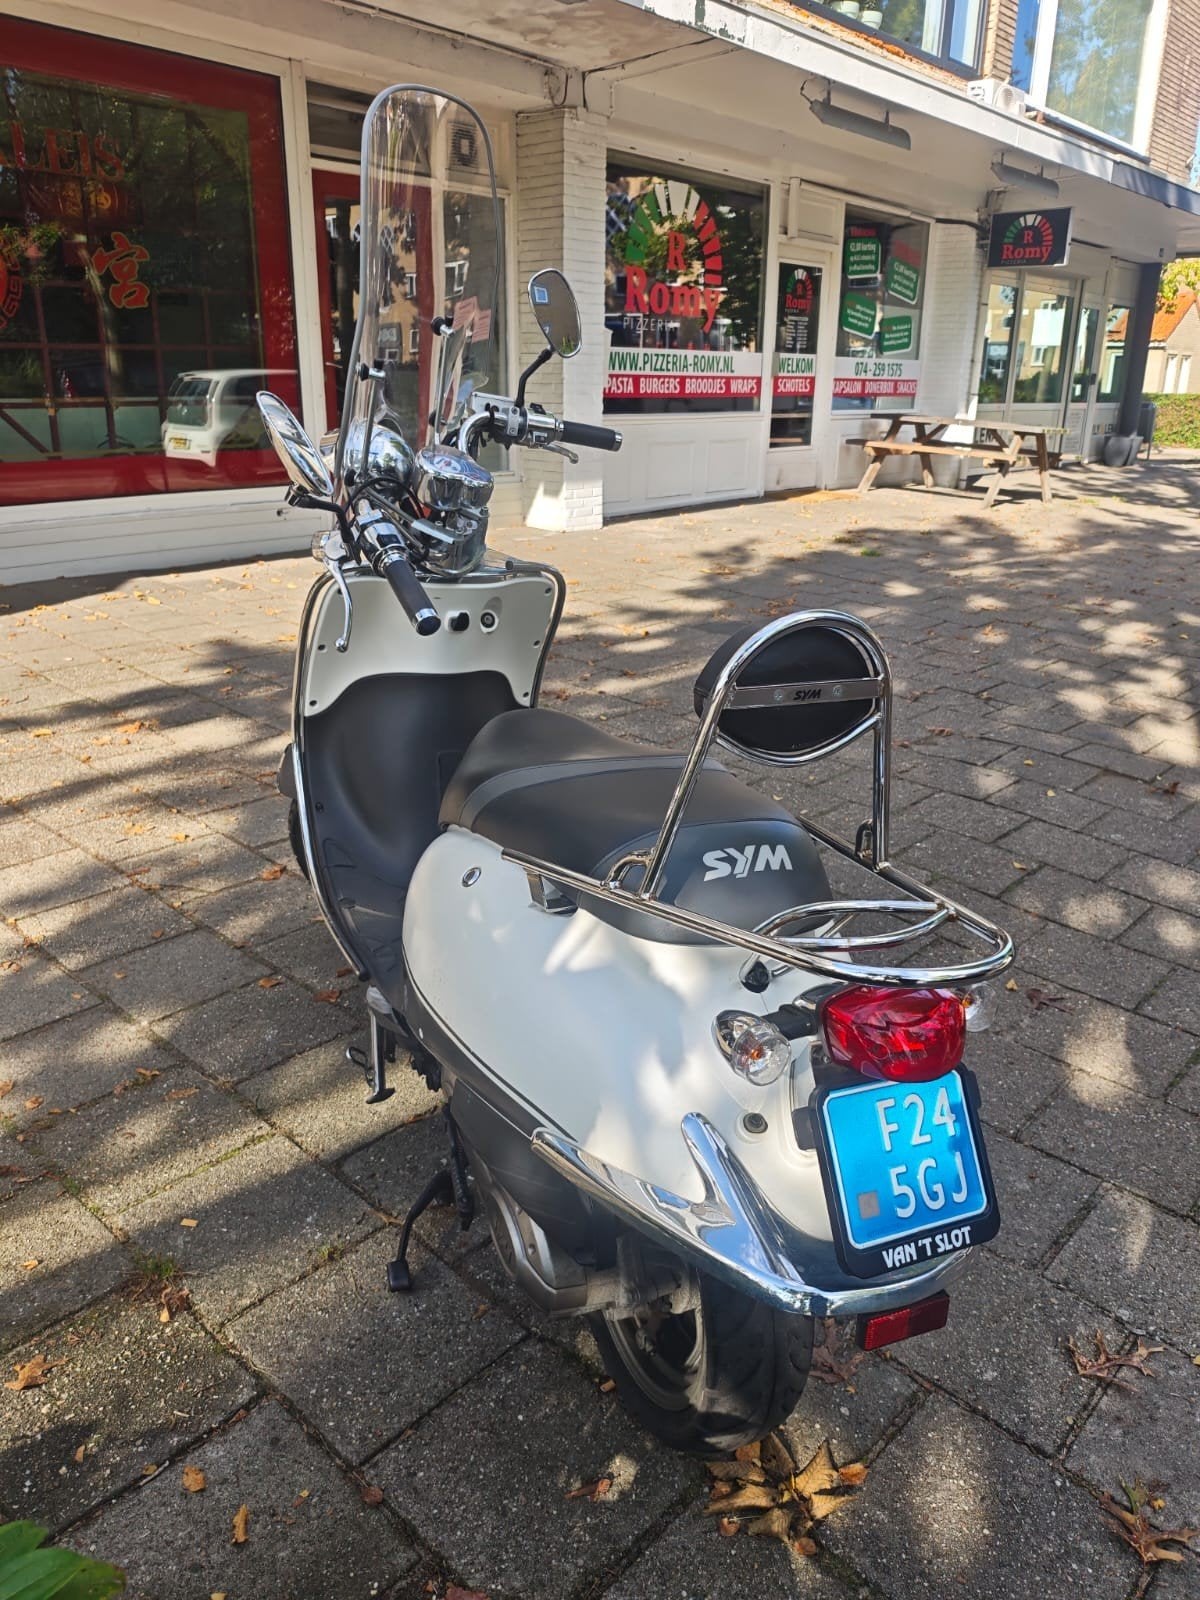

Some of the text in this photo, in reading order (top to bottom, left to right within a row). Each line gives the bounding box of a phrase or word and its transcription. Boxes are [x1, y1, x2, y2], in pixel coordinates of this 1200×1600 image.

[0, 121, 125, 182] LEIS
[668, 231, 686, 271] R
[1002, 243, 1052, 263] Romy
[624, 265, 721, 334] Romy
[779, 357, 813, 374] WELKOM
[855, 362, 868, 376] 074
[873, 363, 885, 376] 259
[887, 363, 903, 377] 1575
[606, 376, 757, 394] PASTA BURGERS BROODJES WRAPS
[777, 378, 810, 393] SCHOTELS
[792, 688, 821, 700] SYM
[702, 844, 793, 882] SYM
[875, 1086, 958, 1152] F24
[889, 1151, 969, 1219] 5GJ
[881, 1242, 918, 1269] VAN
[934, 1226, 971, 1254] SLOT
